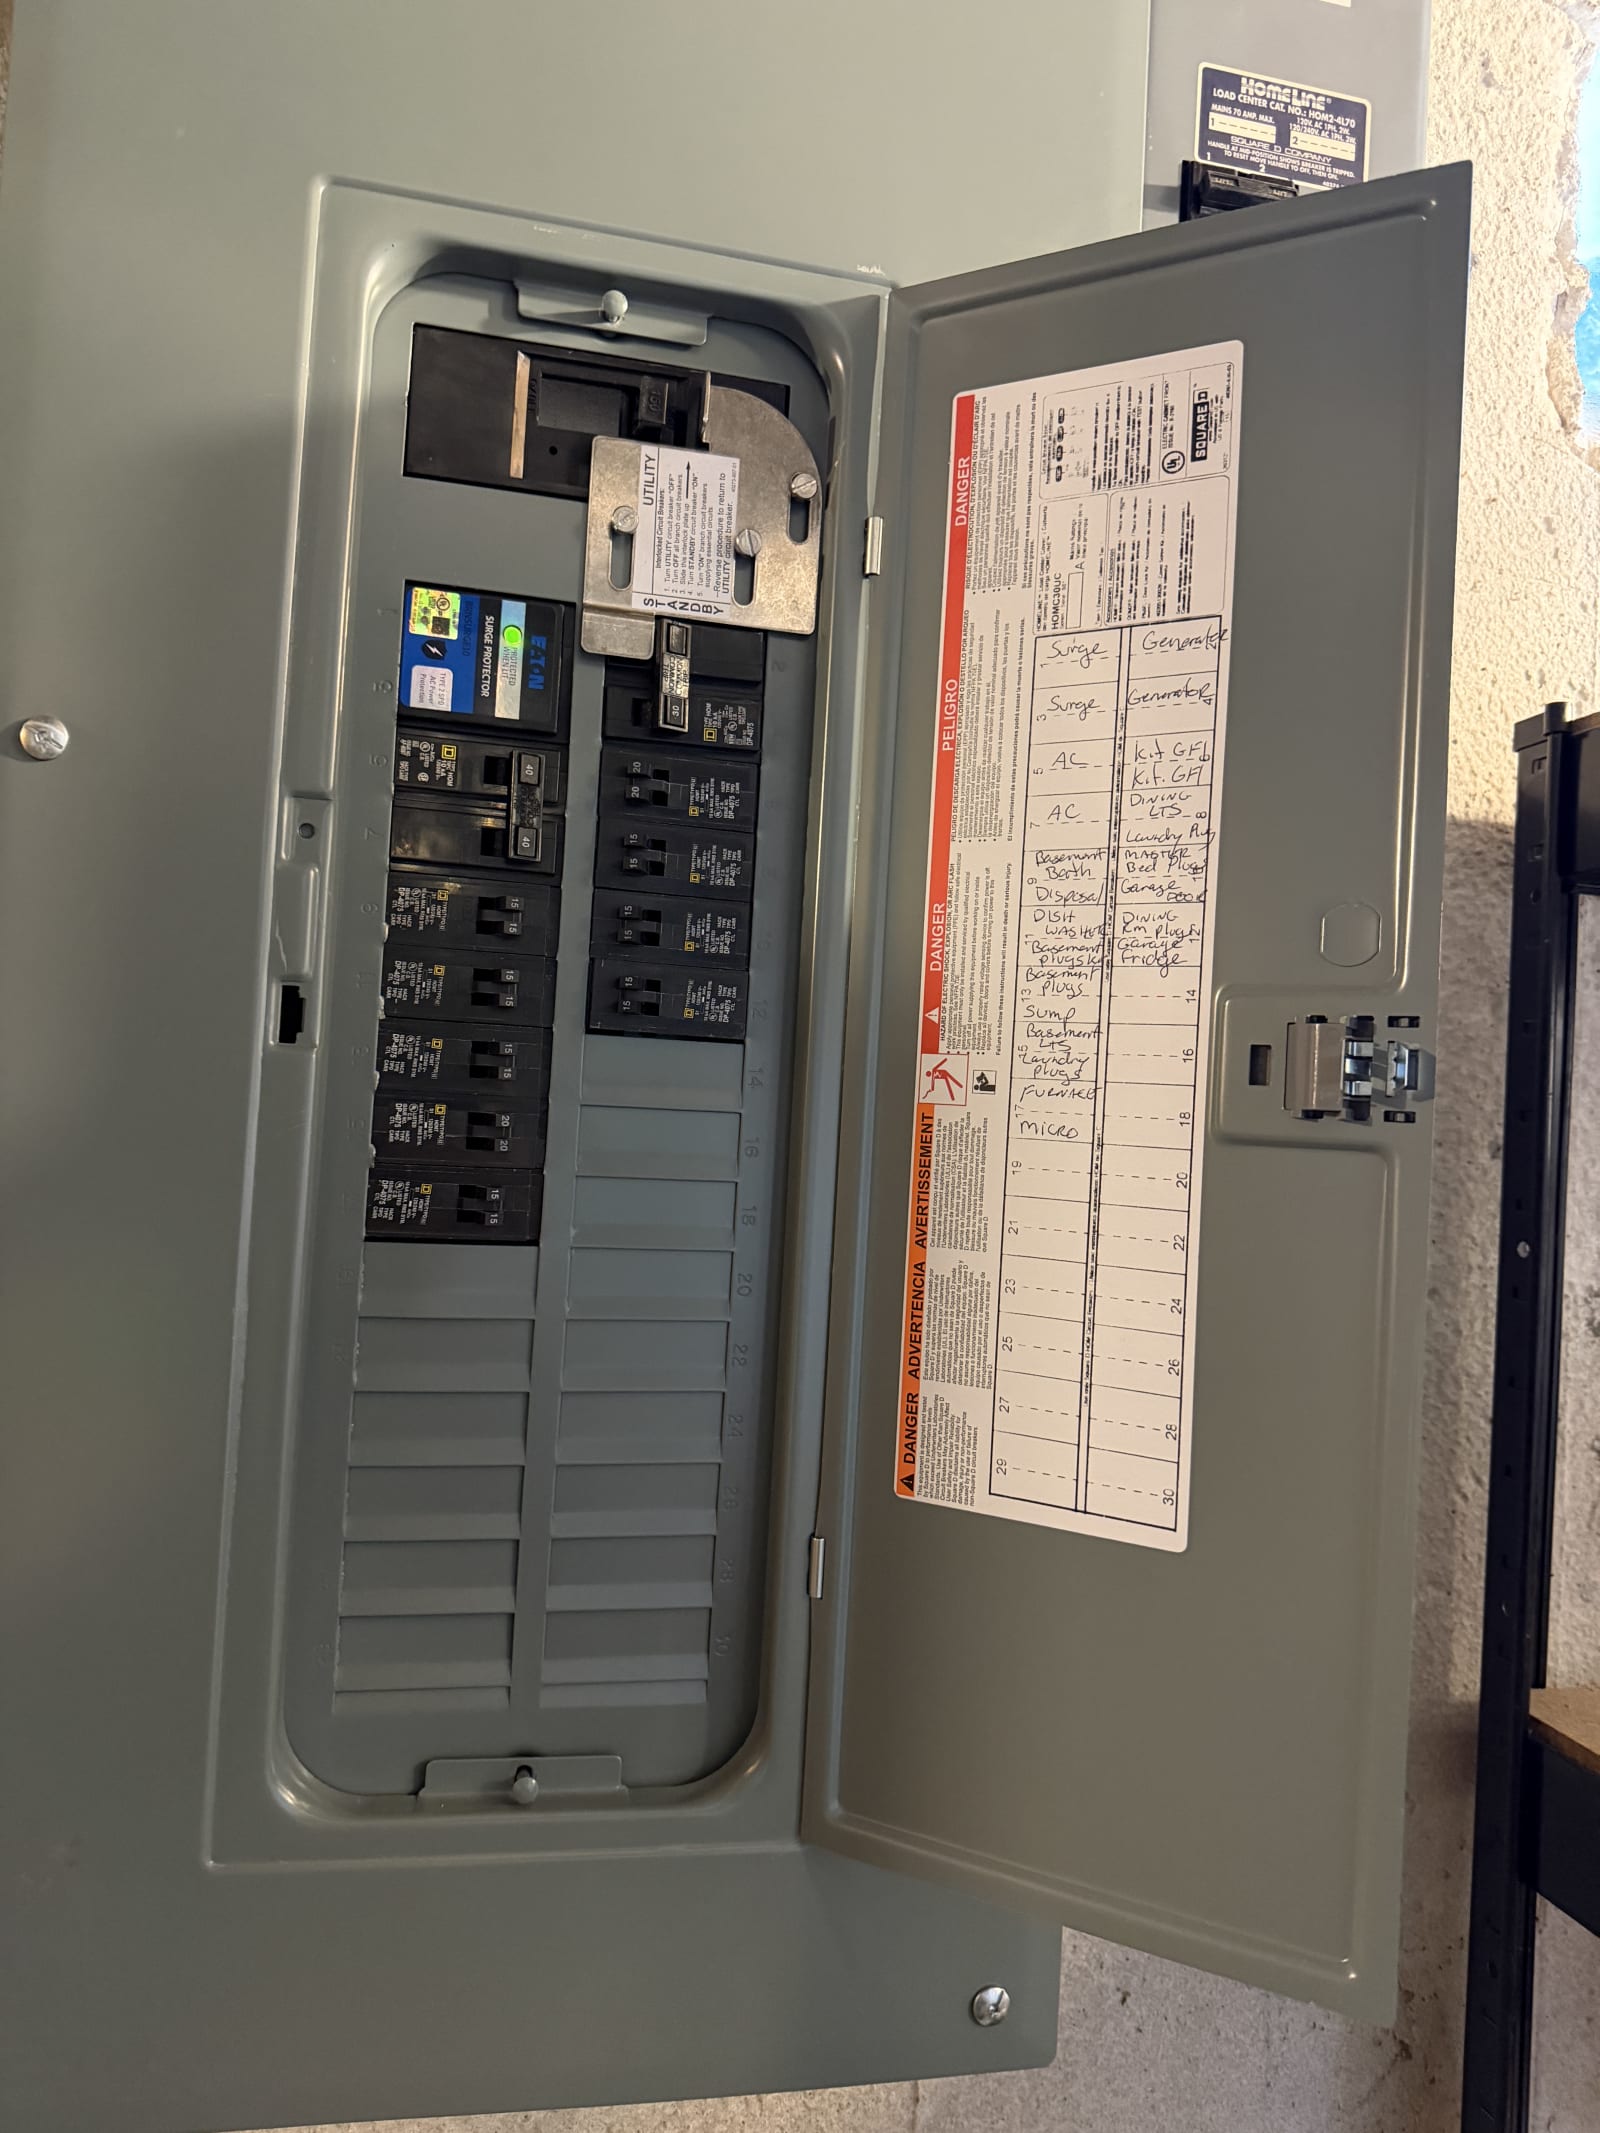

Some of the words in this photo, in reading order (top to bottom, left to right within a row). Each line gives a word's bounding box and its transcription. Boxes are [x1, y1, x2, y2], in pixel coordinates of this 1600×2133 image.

[1213, 88, 1236, 100] LOAD
[1238, 94, 1267, 108] CENTER
[1269, 101, 1285, 112] CAT.
[1288, 105, 1306, 117] NO.:
[1309, 110, 1355, 128] HOM2-4L70
[1292, 137, 1298, 145] 2
[1231, 136, 1269, 150] SQUARE
[1274, 145, 1281, 153] D
[1285, 148, 1332, 163] COMPANY
[1207, 152, 1211, 160] 1
[1259, 165, 1265, 173] 2
[1196, 391, 1208, 401] D
[1195, 404, 1208, 459] SQUARE
[643, 454, 655, 505] UTILITY
[955, 456, 970, 526] DANGER
[716, 517, 725, 557] procedure
[723, 535, 732, 558] circuit
[1075, 561, 1085, 570] A
[722, 561, 730, 593] UTILITY
[484, 616, 494, 644] SURGE
[1047, 640, 1108, 669] Surge
[481, 646, 493, 697] PROTECTOR
[672, 705, 679, 717] 30
[942, 680, 957, 751] PELIGRO
[1047, 695, 1100, 721] Surge
[633, 761, 641, 773] 20
[1052, 752, 1089, 769] AC
[525, 765, 533, 775] 40
[631, 786, 640, 798] 20
[1048, 804, 1080, 820] AC
[522, 837, 531, 848] 40
[630, 834, 638, 844] 15
[630, 858, 638, 868] 15
[511, 898, 519, 908] 15
[624, 906, 632, 916] 15
[509, 923, 517, 933] 15
[624, 930, 632, 940] 15
[930, 903, 945, 971] DANGER
[506, 970, 514, 980] 15
[625, 976, 633, 987] 15
[505, 996, 514, 1007] 15
[1021, 988, 1031, 1002] 13
[1186, 989, 1196, 1003] 14
[623, 1000, 631, 1010] 15
[504, 1044, 512, 1054] 15
[1018, 1045, 1028, 1059] 15
[1183, 1048, 1194, 1063] 16
[504, 1068, 512, 1078] 15
[1014, 1104, 1024, 1118] 17
[1180, 1111, 1190, 1126] 18
[501, 1115, 510, 1127] 20
[500, 1140, 508, 1151] 20
[1012, 1160, 1022, 1175] 19
[915, 1112, 933, 1249] AVERTISSEMENT
[1176, 1172, 1188, 1189] 20
[491, 1189, 499, 1199] 15
[490, 1214, 498, 1224] 15
[1008, 1220, 1018, 1235] 21
[1173, 1234, 1185, 1251] 22
[1005, 1278, 1016, 1295] 23
[1170, 1298, 1182, 1314] 24
[908, 1261, 925, 1380] ADVERTENCIA
[1002, 1336, 1013, 1352] 25
[1168, 1359, 1180, 1376] 26
[999, 1397, 1010, 1413] 27
[904, 1393, 918, 1464] DANGER
[1166, 1423, 1177, 1440] 28
[996, 1458, 1007, 1476] 29
[1163, 1488, 1174, 1506] 30
